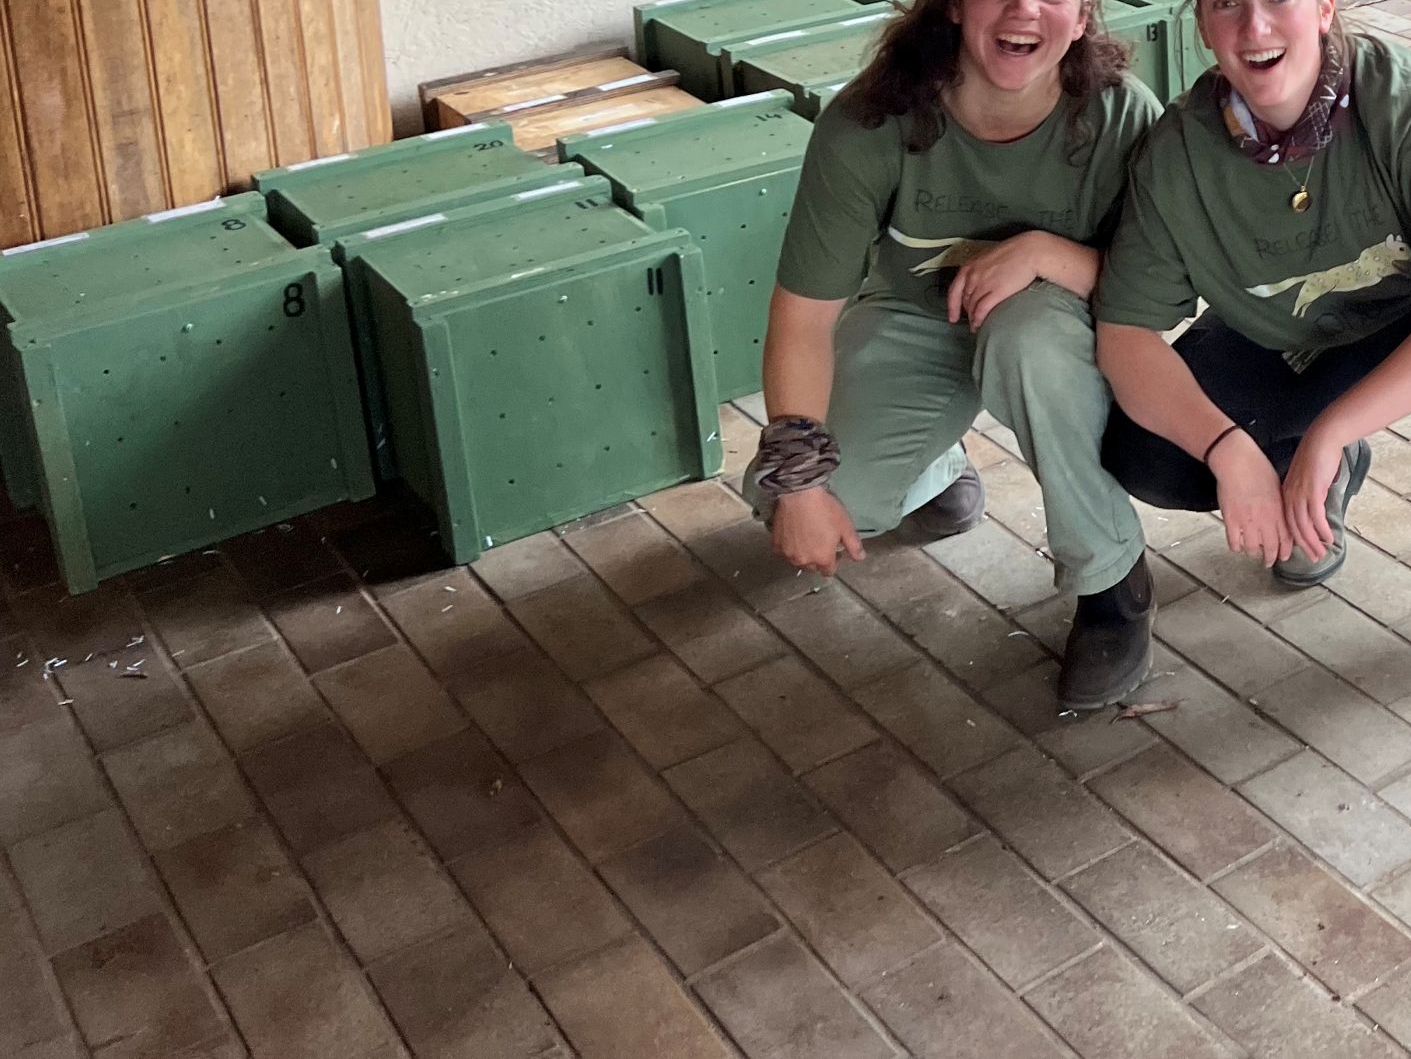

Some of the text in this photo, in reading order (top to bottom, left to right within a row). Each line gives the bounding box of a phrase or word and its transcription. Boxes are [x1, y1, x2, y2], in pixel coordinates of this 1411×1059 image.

[1147, 22, 1158, 42] 13
[755, 110, 783, 123] 14
[473, 140, 504, 153] 20
[574, 198, 599, 210] 11
[914, 188, 1010, 220] RELEASE
[221, 218, 246, 231] 8
[647, 267, 664, 296] 11
[283, 282, 306, 318] 8
